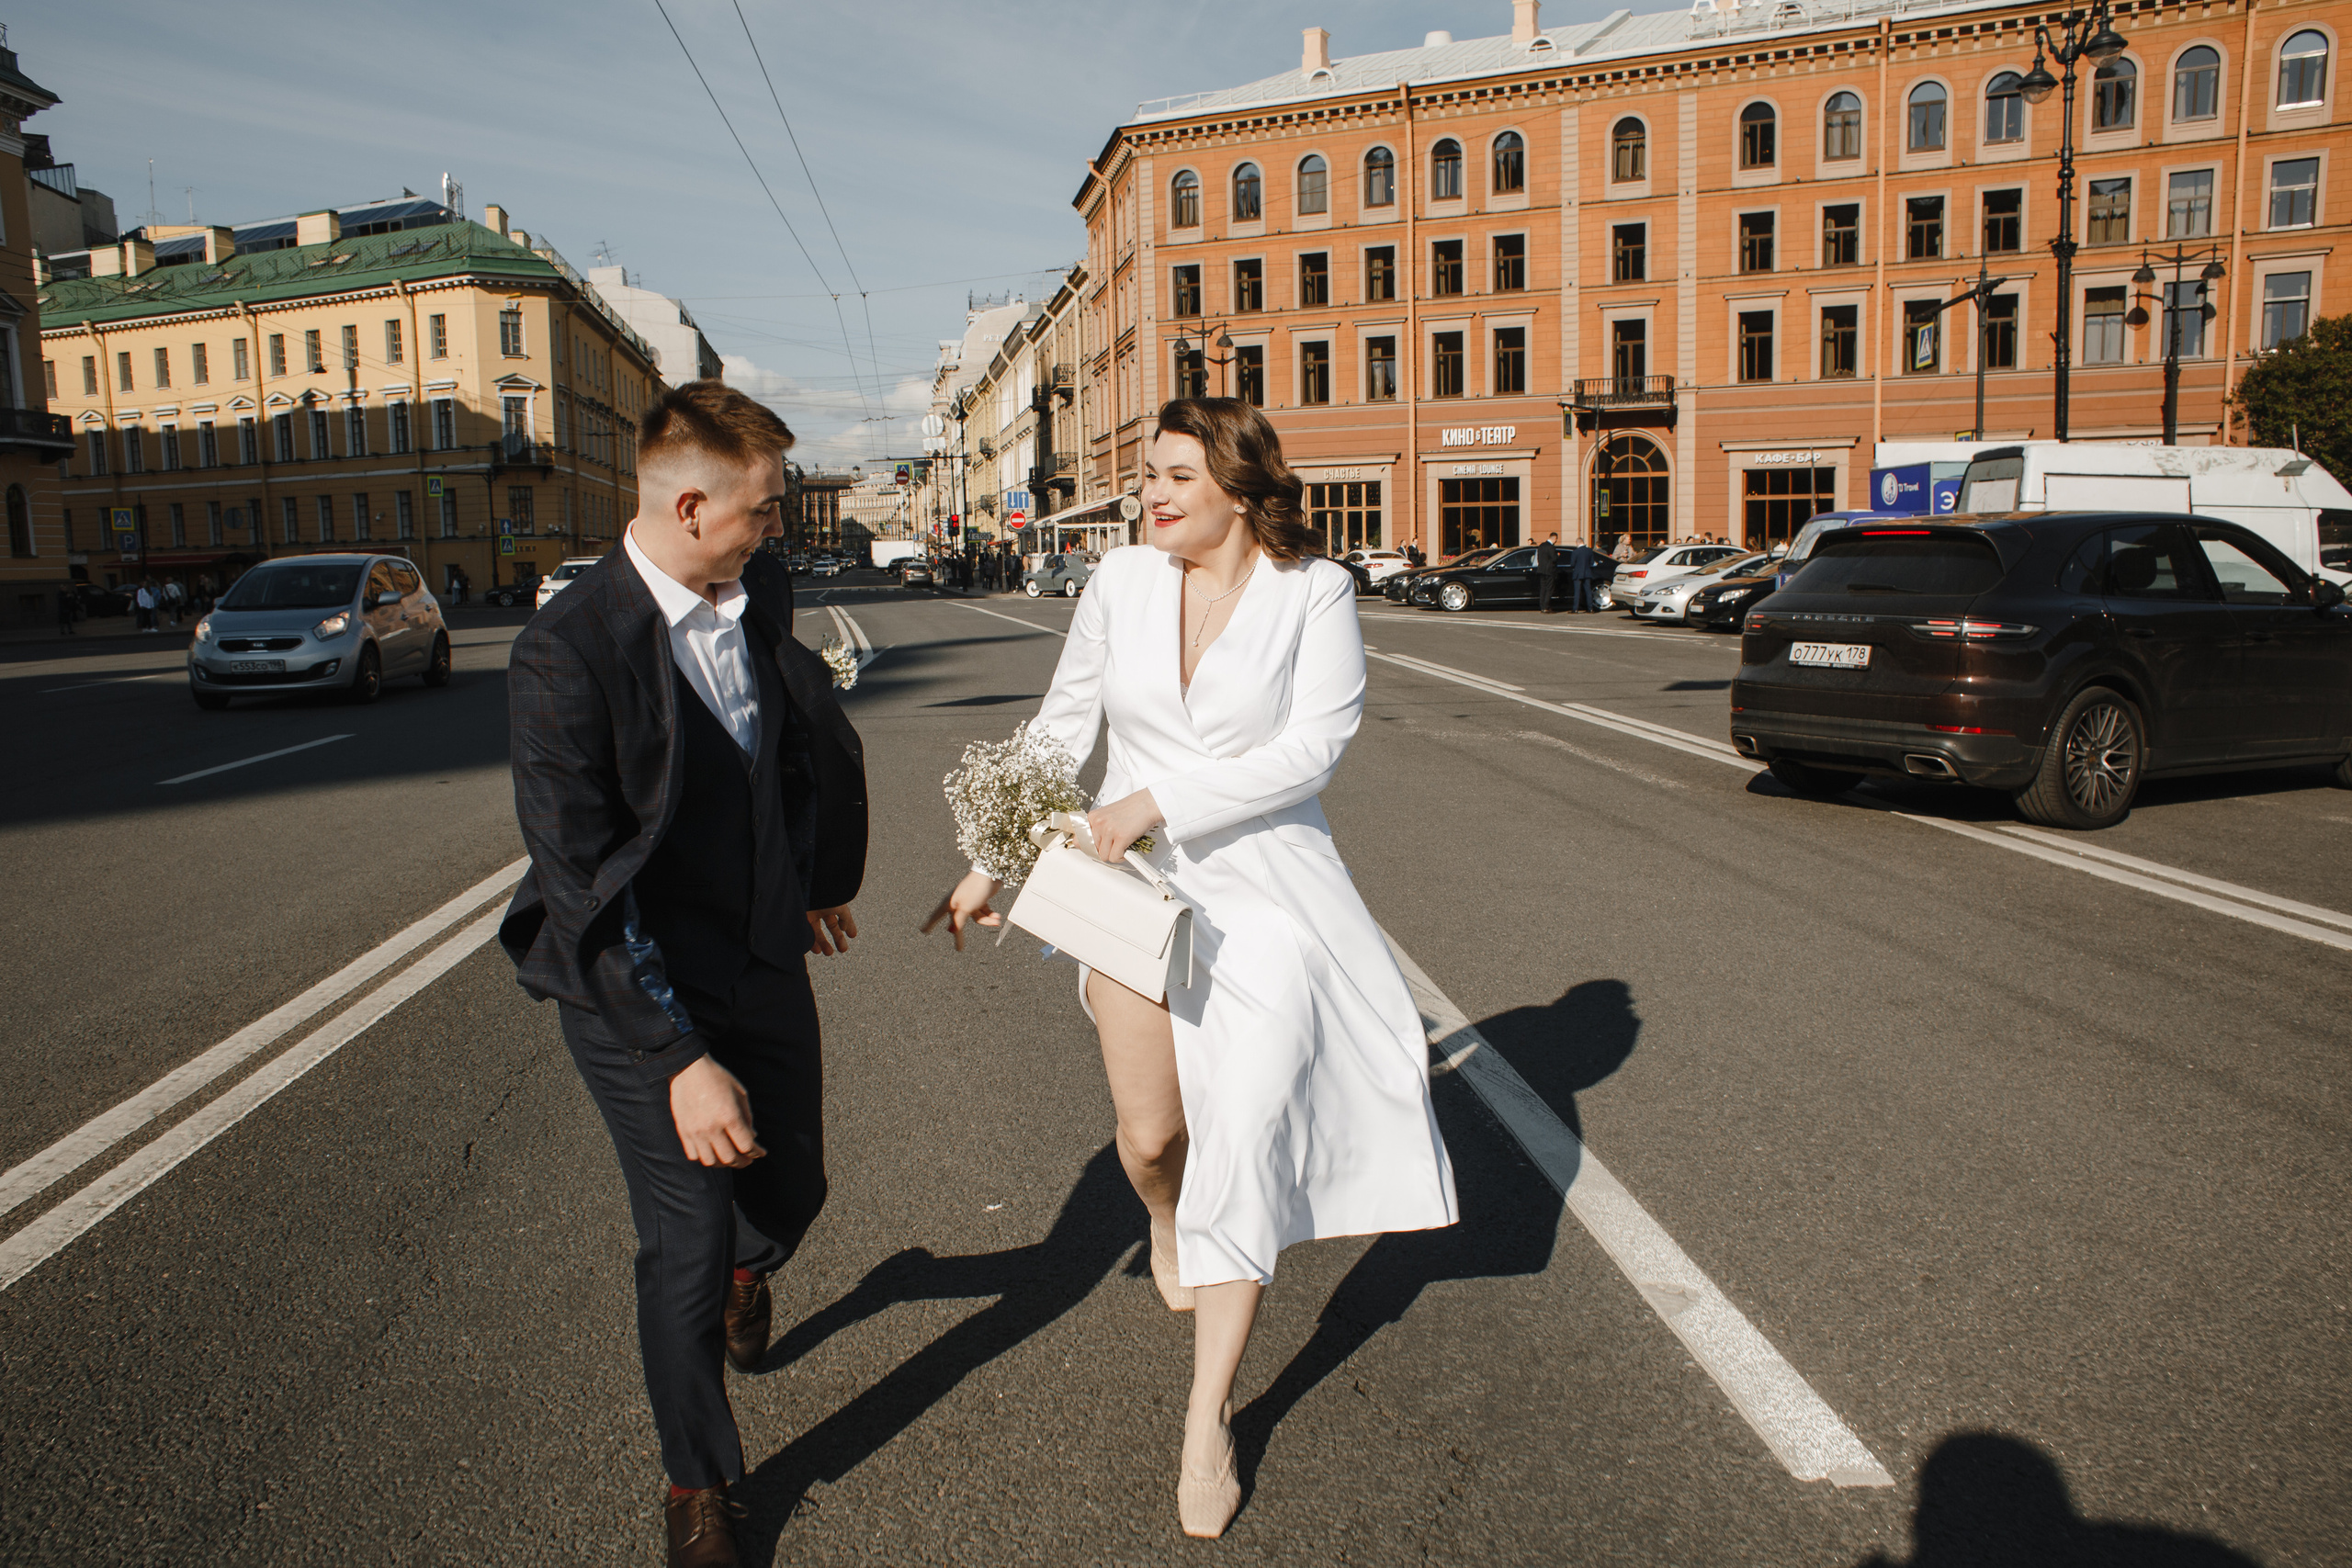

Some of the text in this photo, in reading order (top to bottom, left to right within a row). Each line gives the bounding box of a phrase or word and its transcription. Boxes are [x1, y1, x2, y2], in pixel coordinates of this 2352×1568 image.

[1442, 428, 1475, 446] КИНО
[1481, 425, 1516, 446] ТЕАТР
[1324, 468, 1361, 479] СЧАСТЬЕ
[1453, 464, 1504, 476] CINEMA LOUNGE
[1847, 647, 1866, 660] 178
